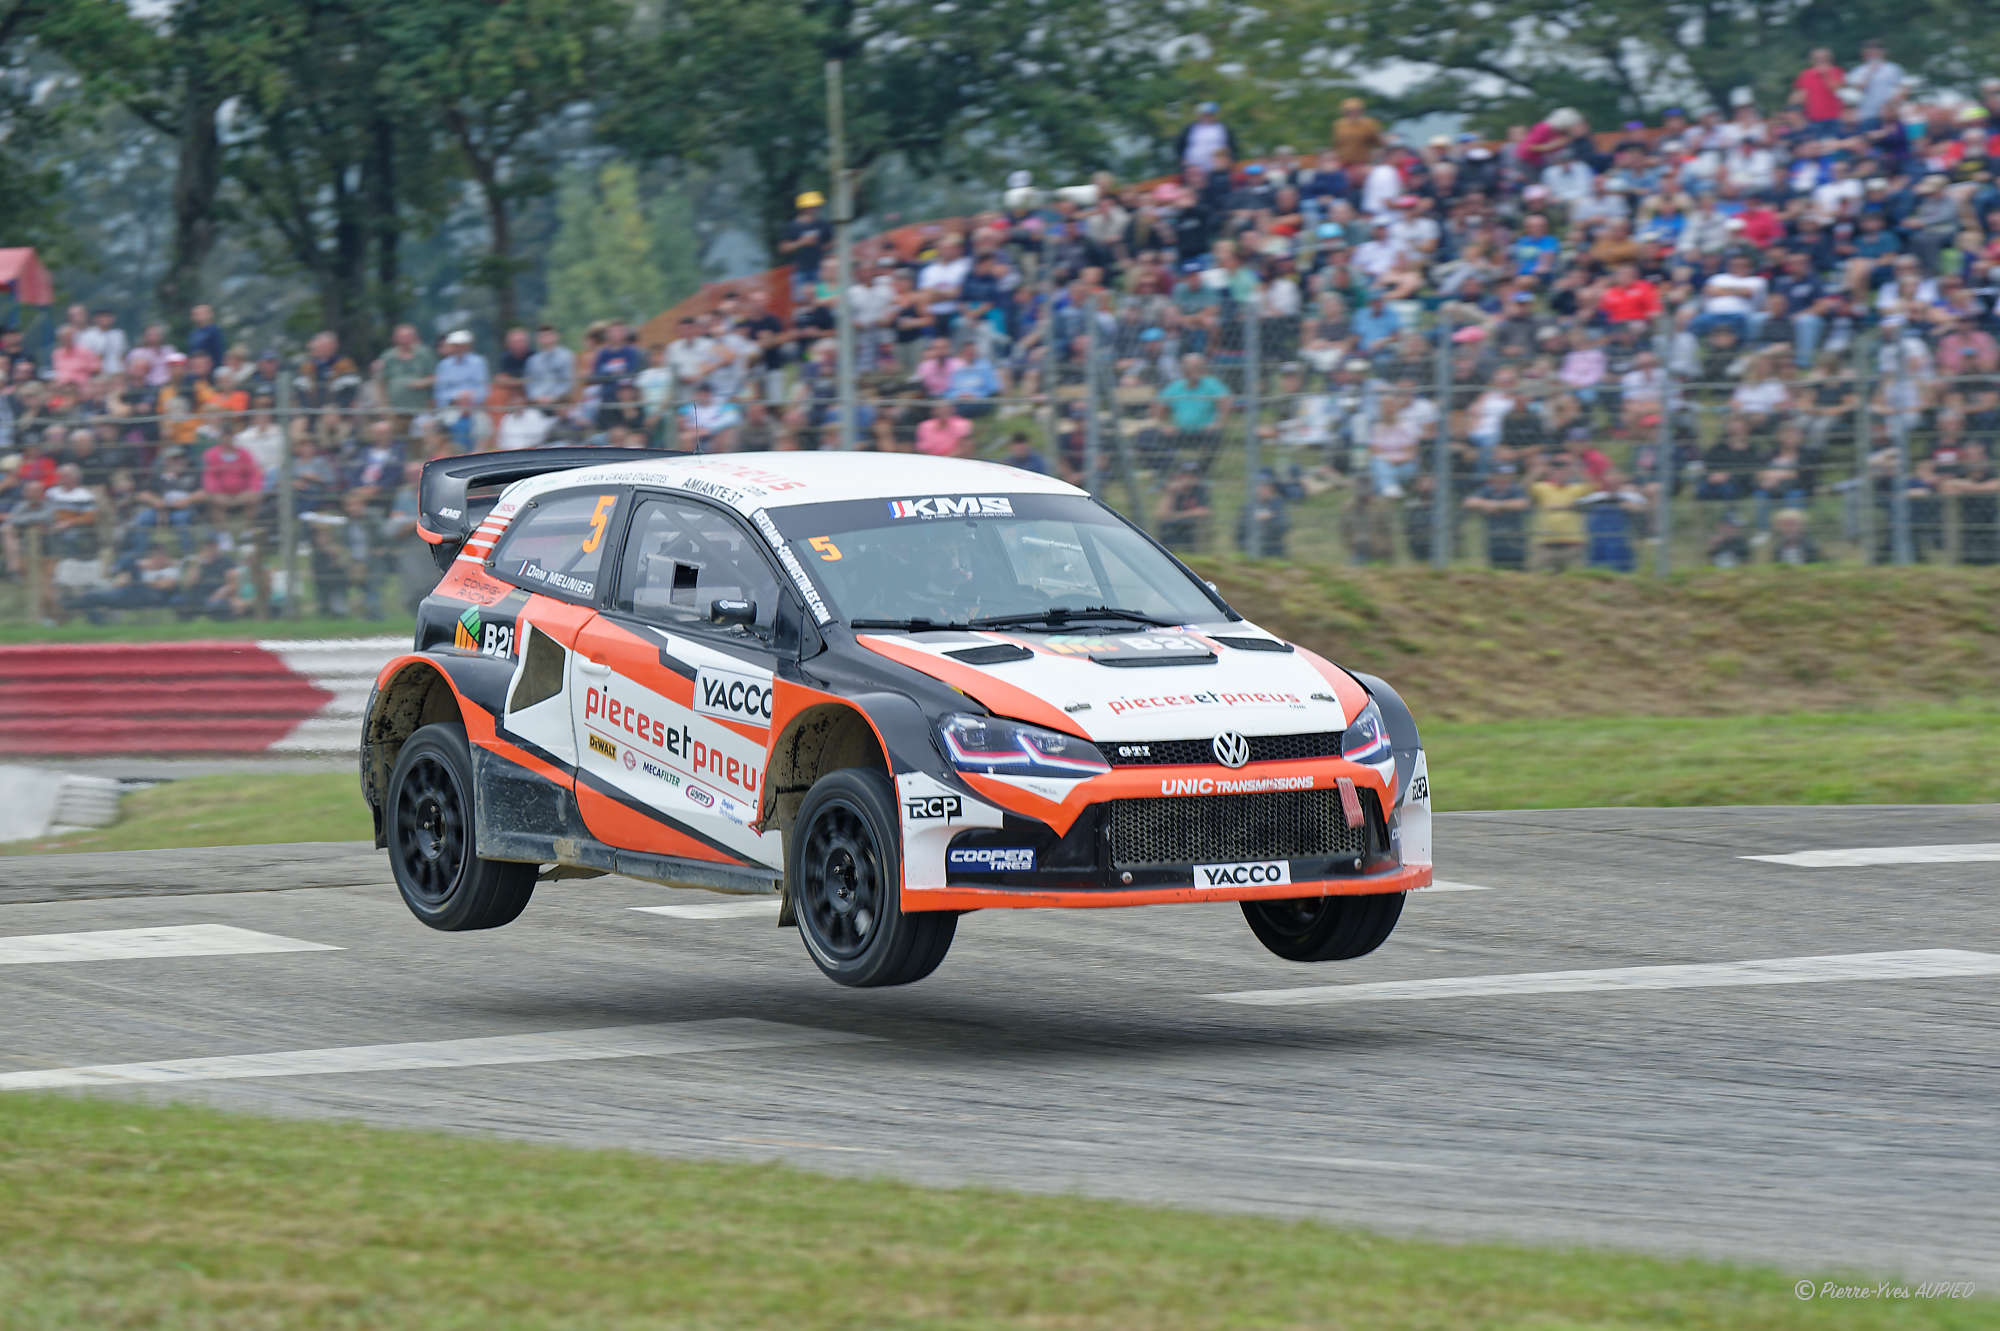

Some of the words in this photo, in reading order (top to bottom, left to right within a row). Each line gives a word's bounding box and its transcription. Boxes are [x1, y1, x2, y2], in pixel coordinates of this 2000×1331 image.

[681, 477, 729, 500] AMIANTE
[901, 497, 1013, 517] KMS
[583, 495, 616, 554] 5
[807, 536, 842, 562] 5
[546, 571, 594, 596] MEUNIER
[482, 622, 515, 660] B2i
[1107, 690, 1300, 715] piecesetpneus
[585, 685, 764, 793] piecesetpneu
[1118, 745, 1150, 757] GTI
[642, 761, 681, 788] MECAFILTER
[1161, 778, 1213, 796] UNIC
[1216, 775, 1314, 793] TRANSMISSIONS
[904, 797, 958, 826] RCP
[950, 849, 1034, 863] COOPER
[989, 861, 1032, 871] TIRES
[1203, 864, 1281, 887] YACCO
